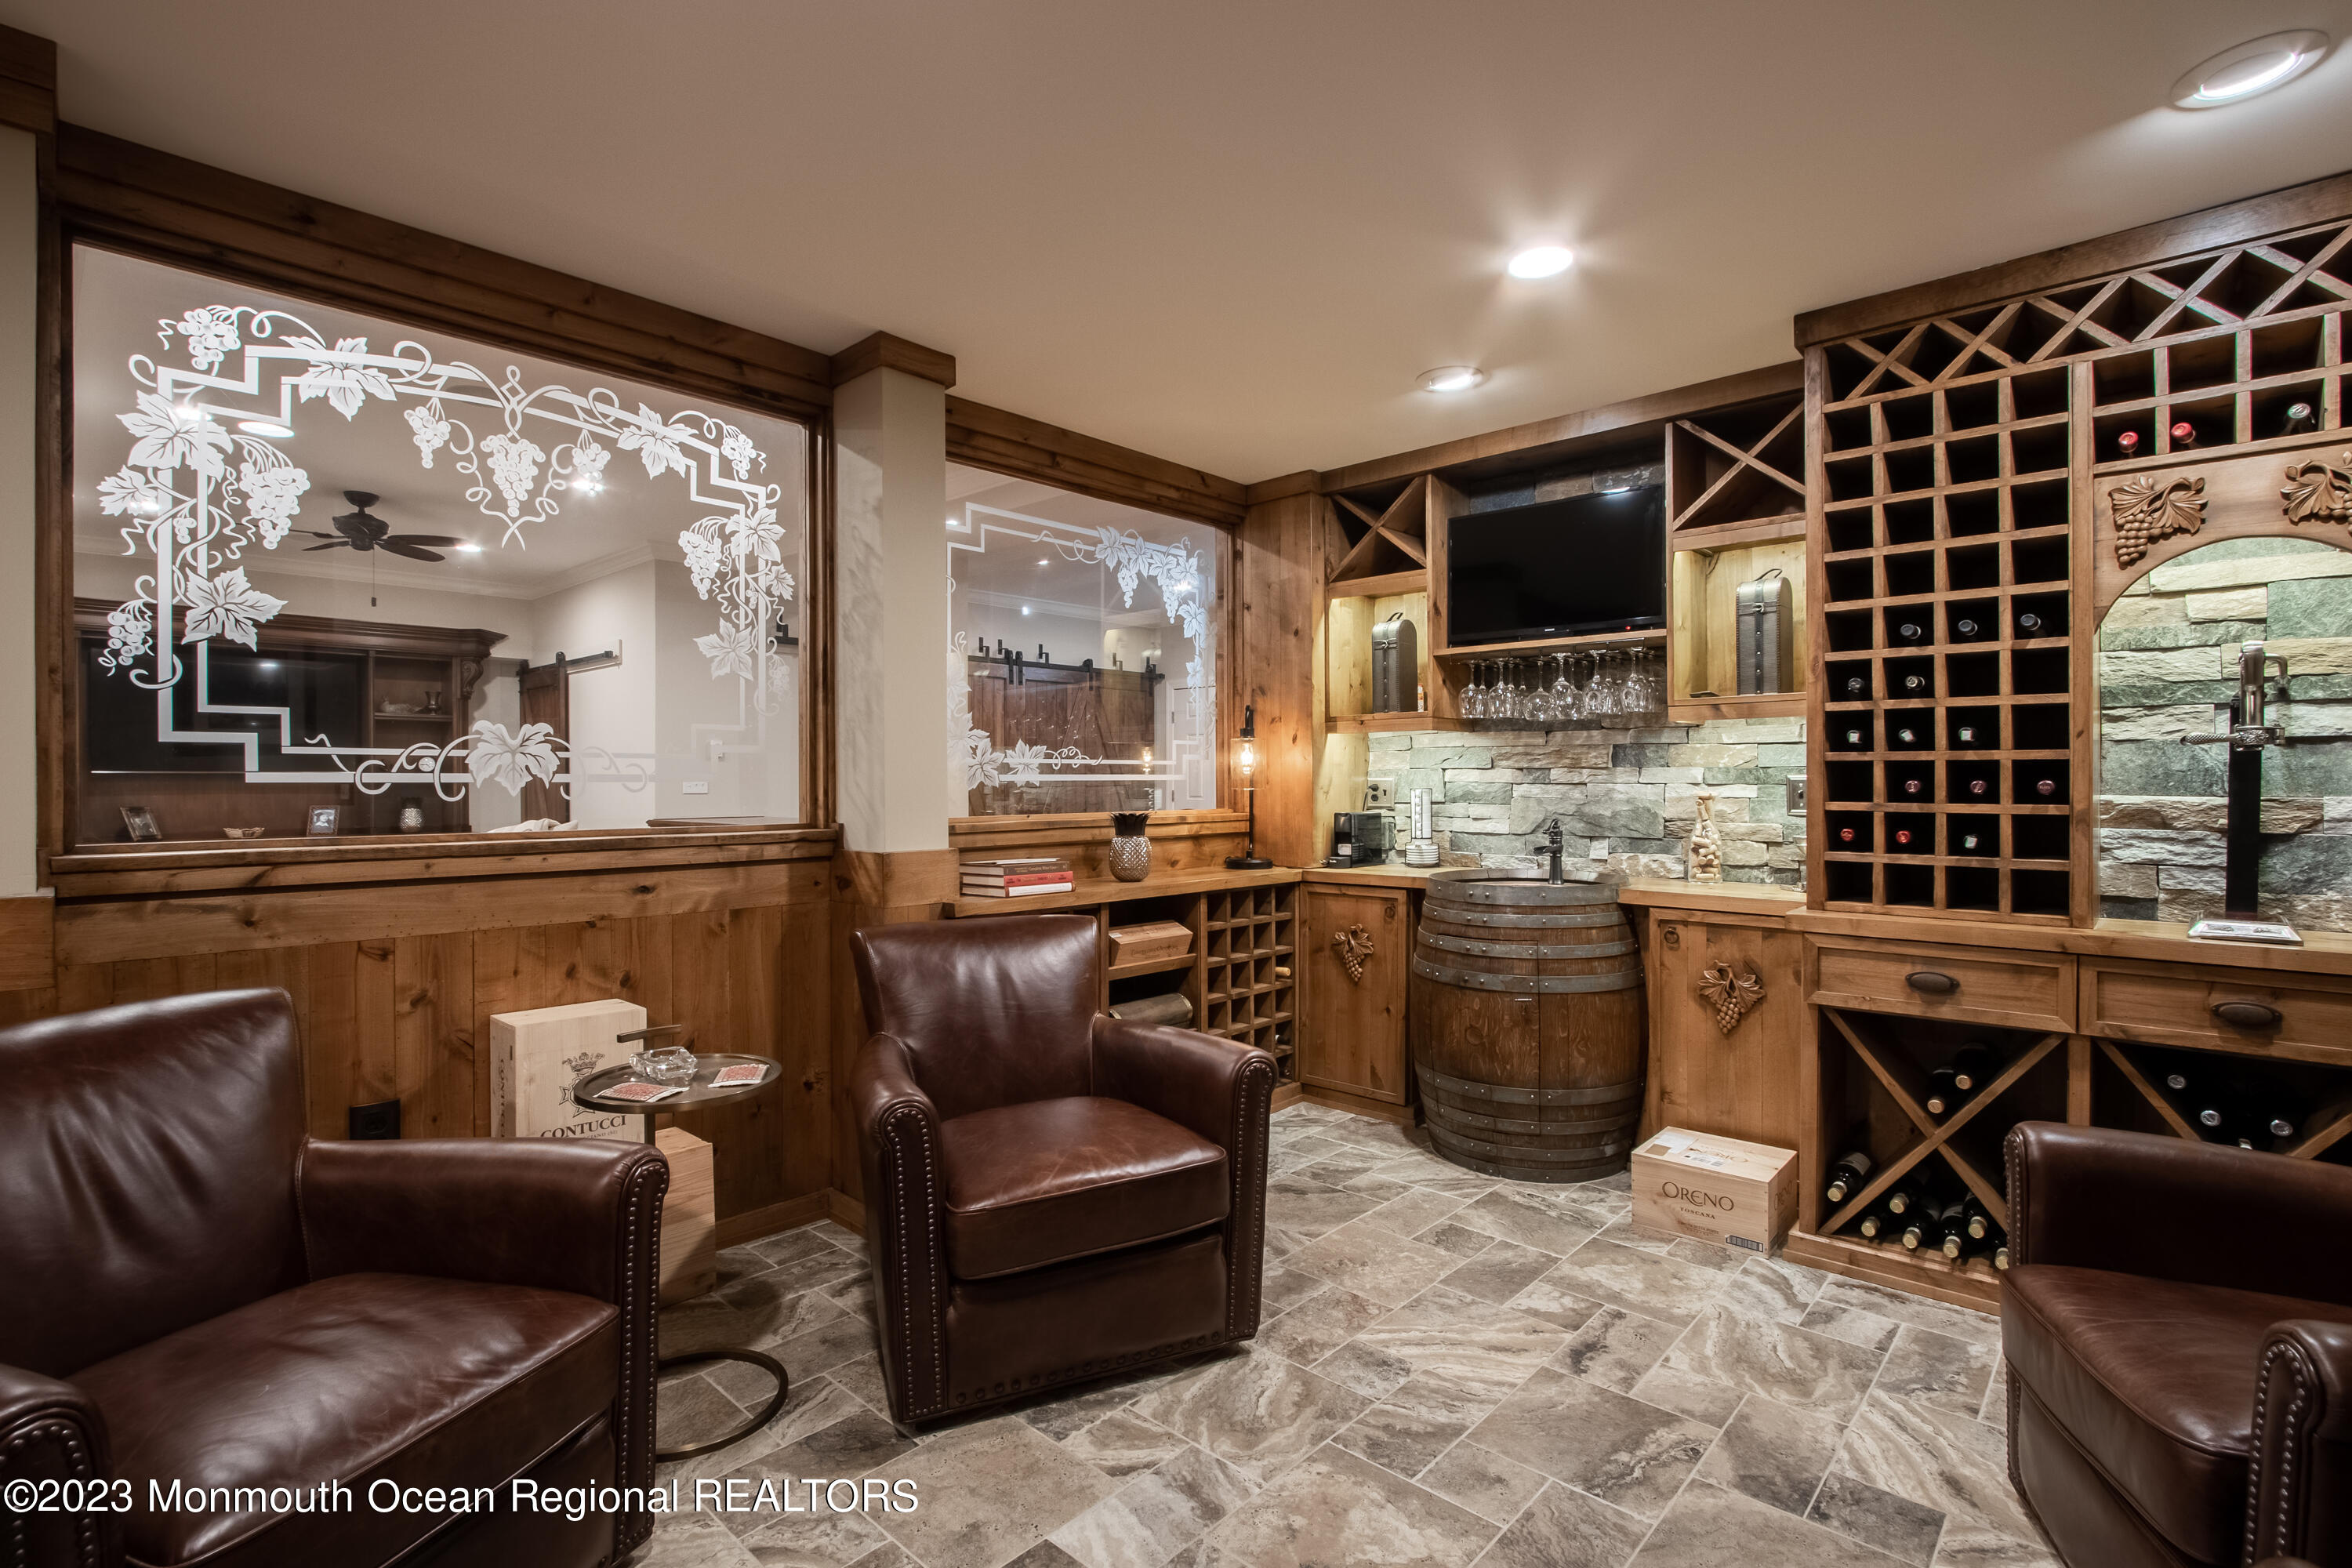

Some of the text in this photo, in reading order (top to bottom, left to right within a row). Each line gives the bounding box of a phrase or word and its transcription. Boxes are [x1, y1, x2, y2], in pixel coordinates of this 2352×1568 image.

[540, 1115, 627, 1138] CONTUCCI
[1661, 1181, 1734, 1211] ORENO
[1680, 1207, 1715, 1220] TOSCANA
